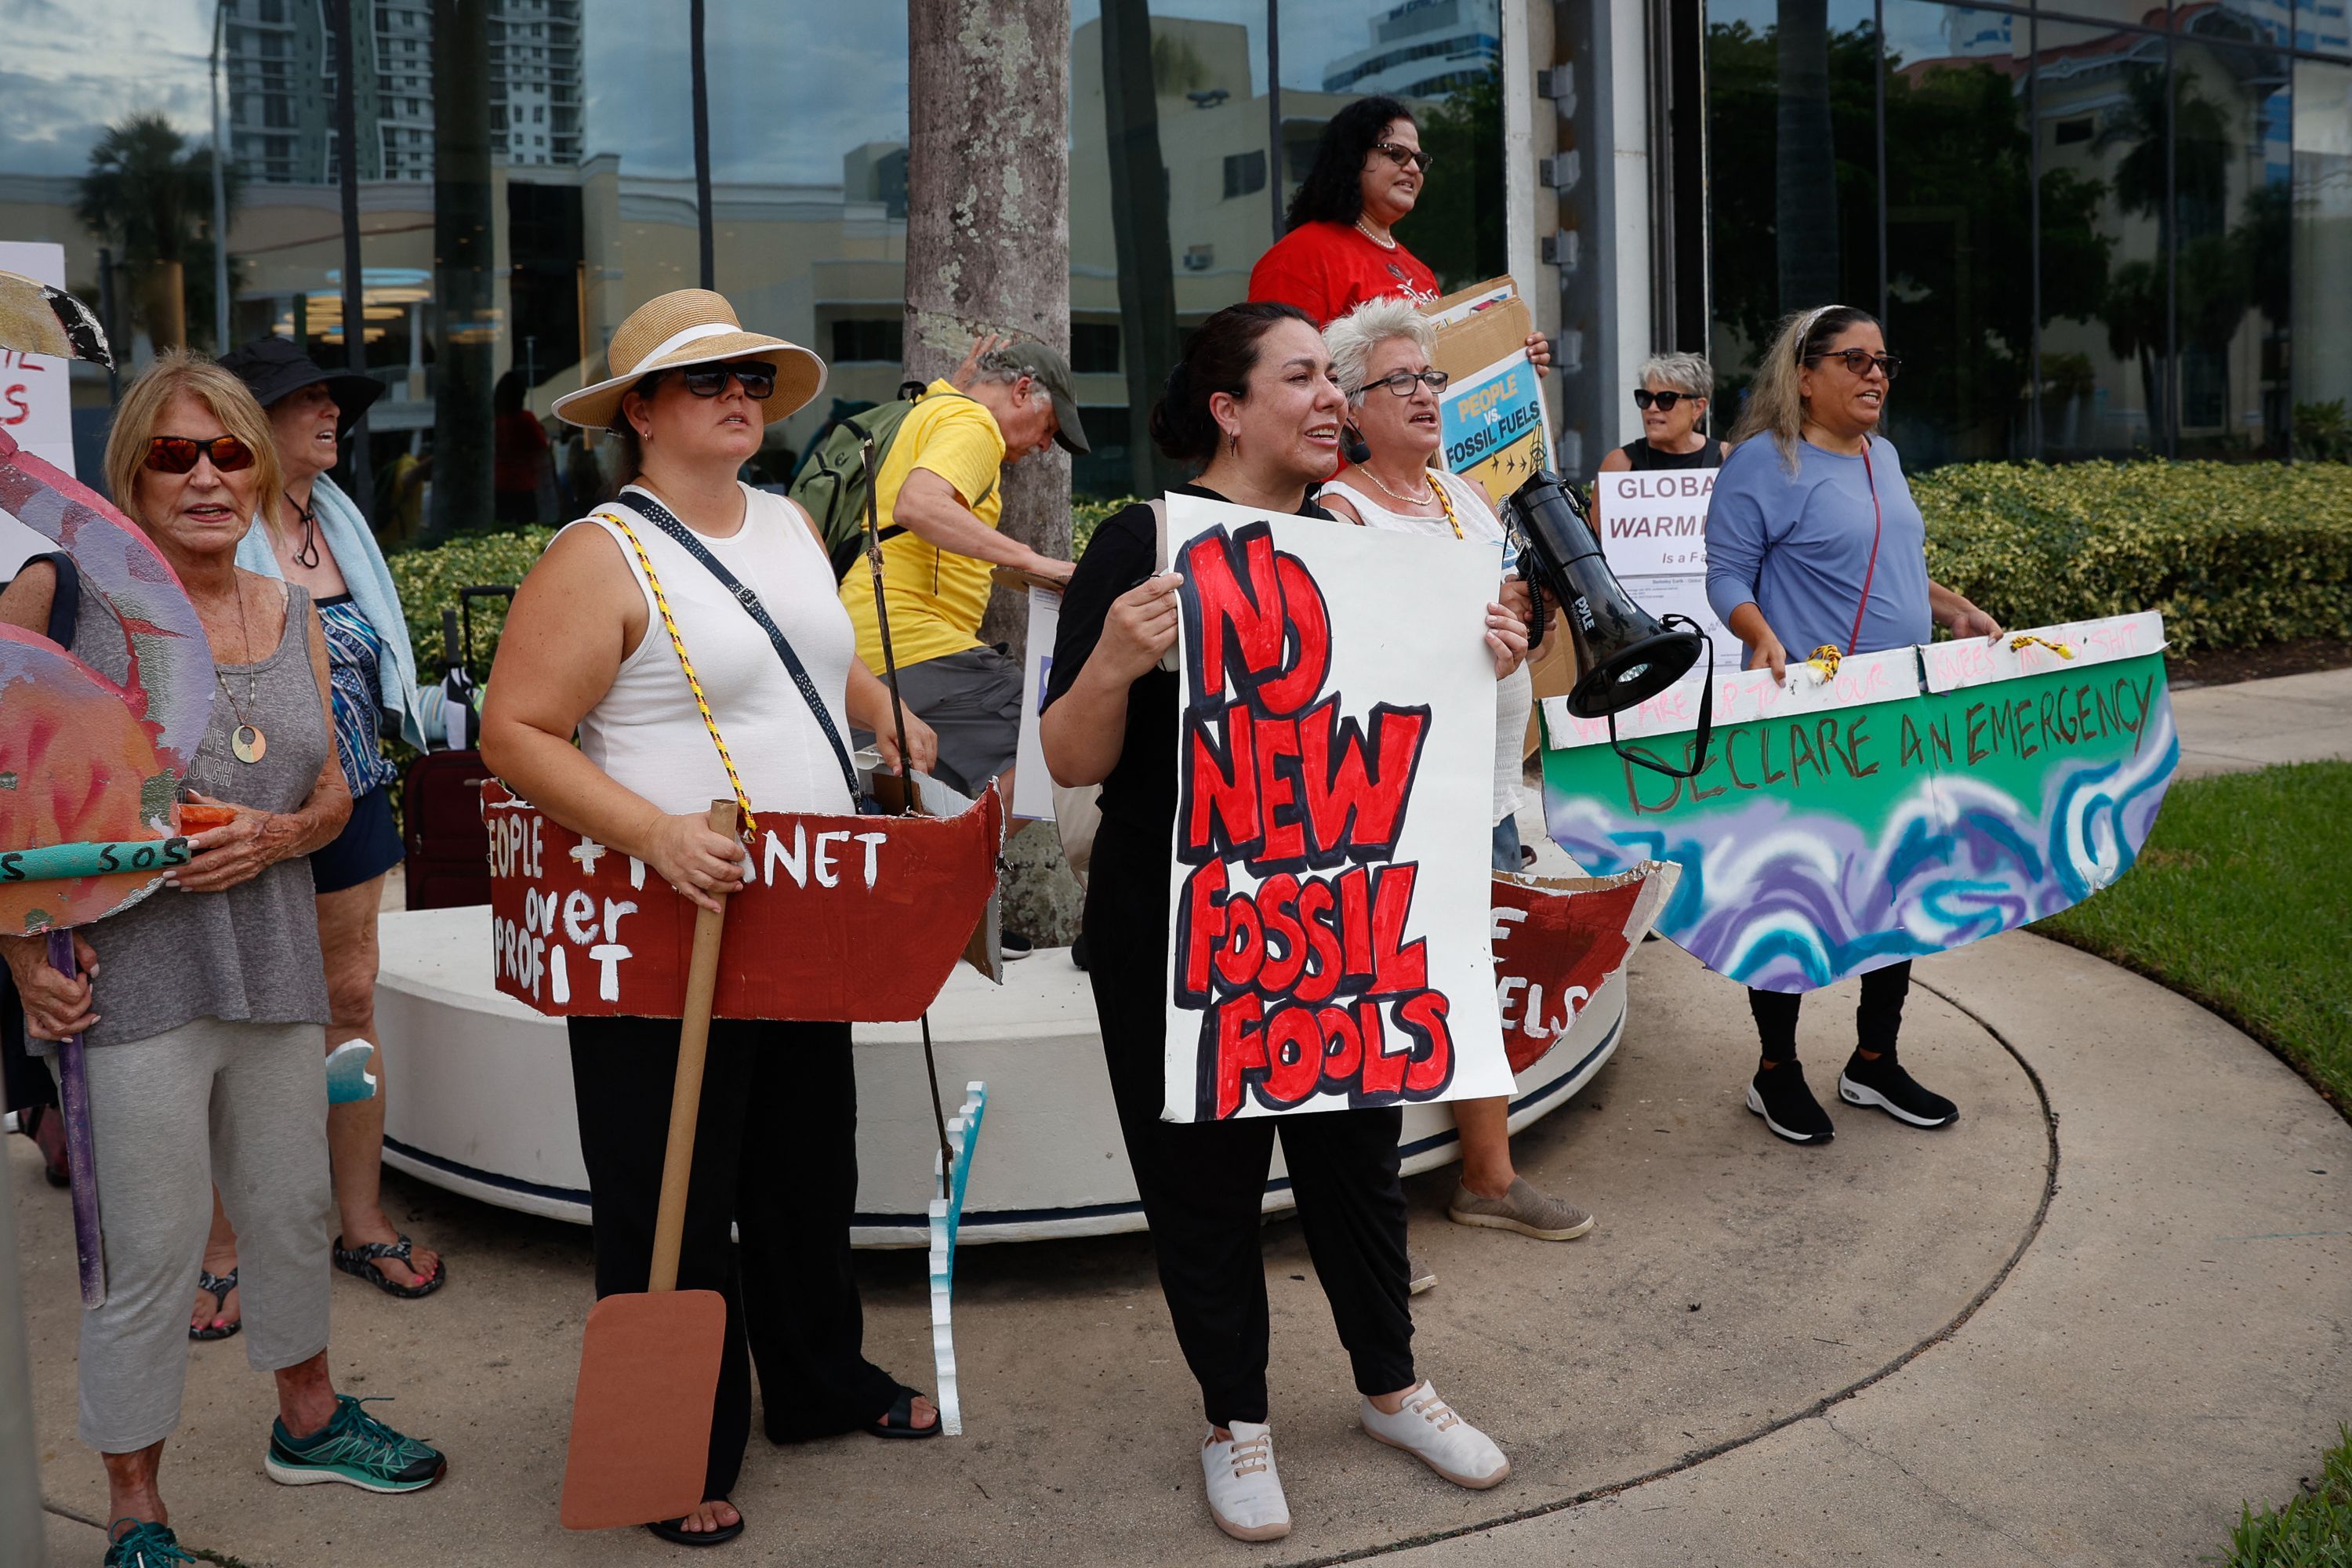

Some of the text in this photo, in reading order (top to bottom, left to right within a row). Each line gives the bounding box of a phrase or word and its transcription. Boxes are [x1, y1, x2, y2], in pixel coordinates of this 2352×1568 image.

[1457, 373, 1519, 423] PEOPLE
[1484, 408, 1501, 426] VS.
[1446, 401, 1541, 469] FOSSIL FUELS
[1662, 553, 1674, 564] Is
[1678, 554, 1686, 563] a
[1174, 521, 1333, 717] NO
[2090, 622, 2138, 658] SHIT
[1623, 673, 2154, 816] DECLARE AN EMERGENCY
[1176, 691, 1432, 878] NEW
[98, 837, 189, 873] SOS
[525, 887, 638, 945] over
[1174, 855, 1427, 1010] FOSSIL
[1195, 989, 1455, 1123] FOOLS
